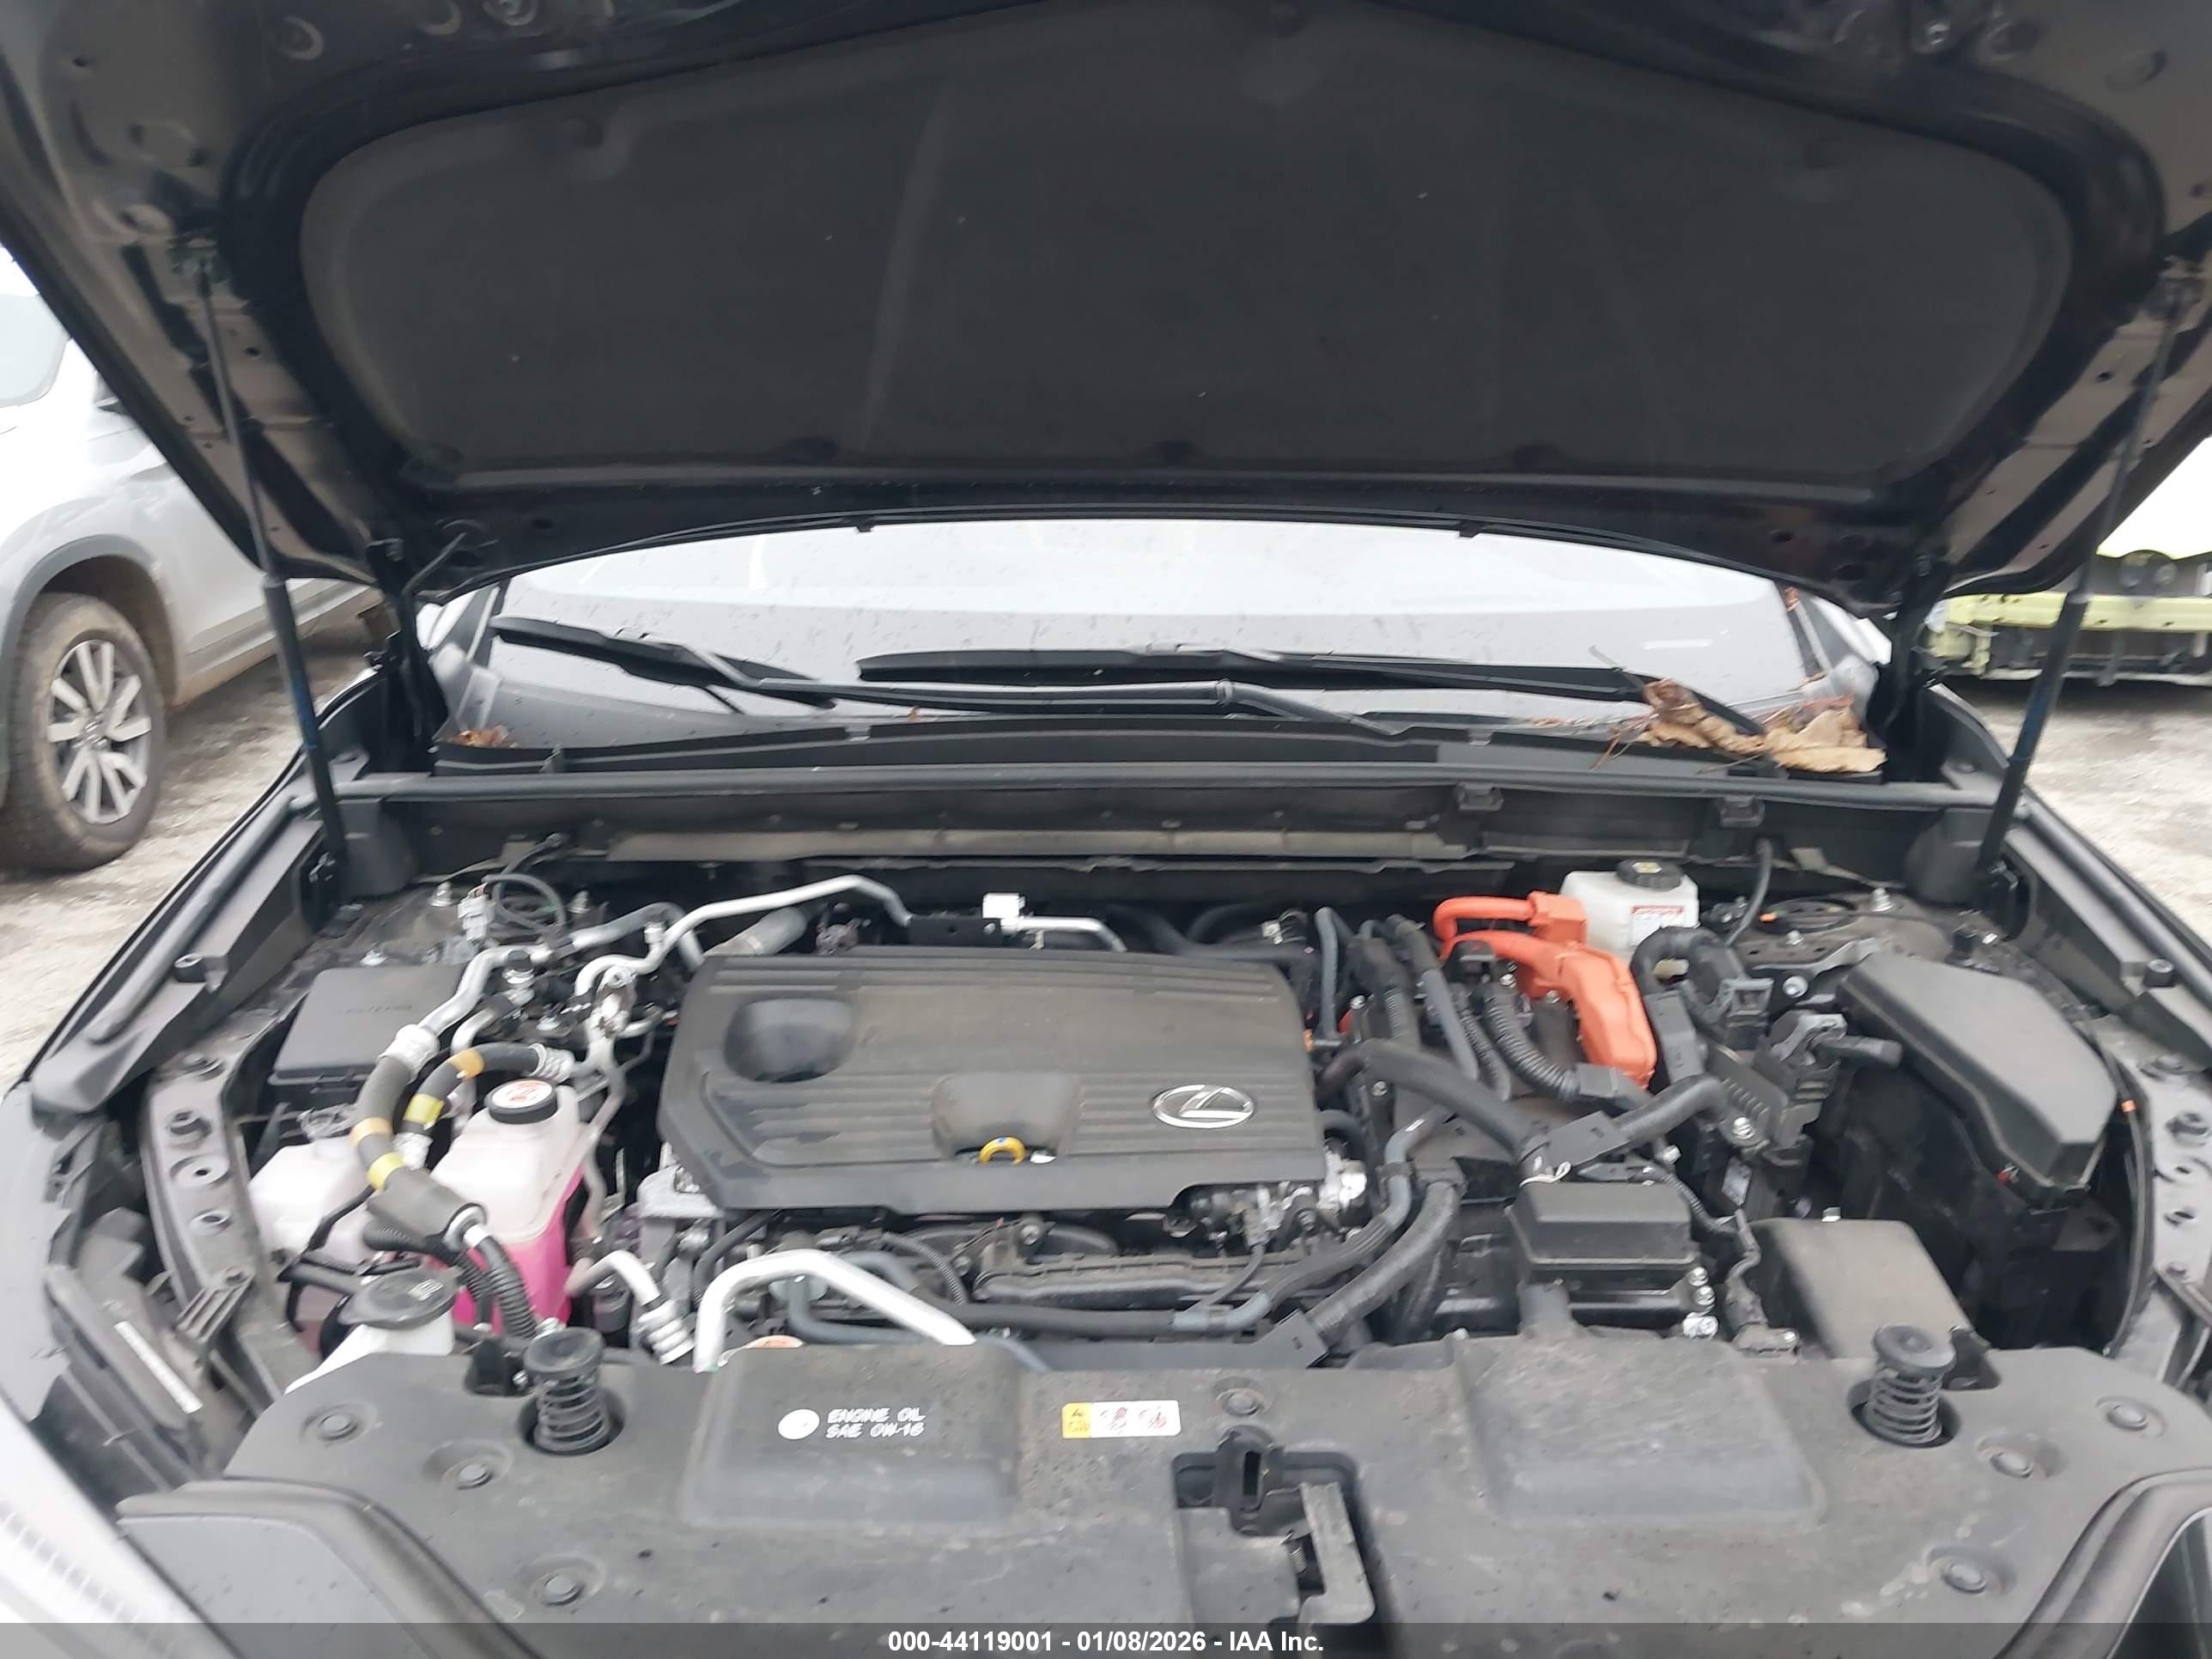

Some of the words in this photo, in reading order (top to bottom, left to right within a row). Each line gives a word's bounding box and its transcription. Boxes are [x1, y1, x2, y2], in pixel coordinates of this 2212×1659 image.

[827, 1407, 891, 1424] ENGINE
[896, 1407, 927, 1422] OIL
[825, 1423, 863, 1439] SAE
